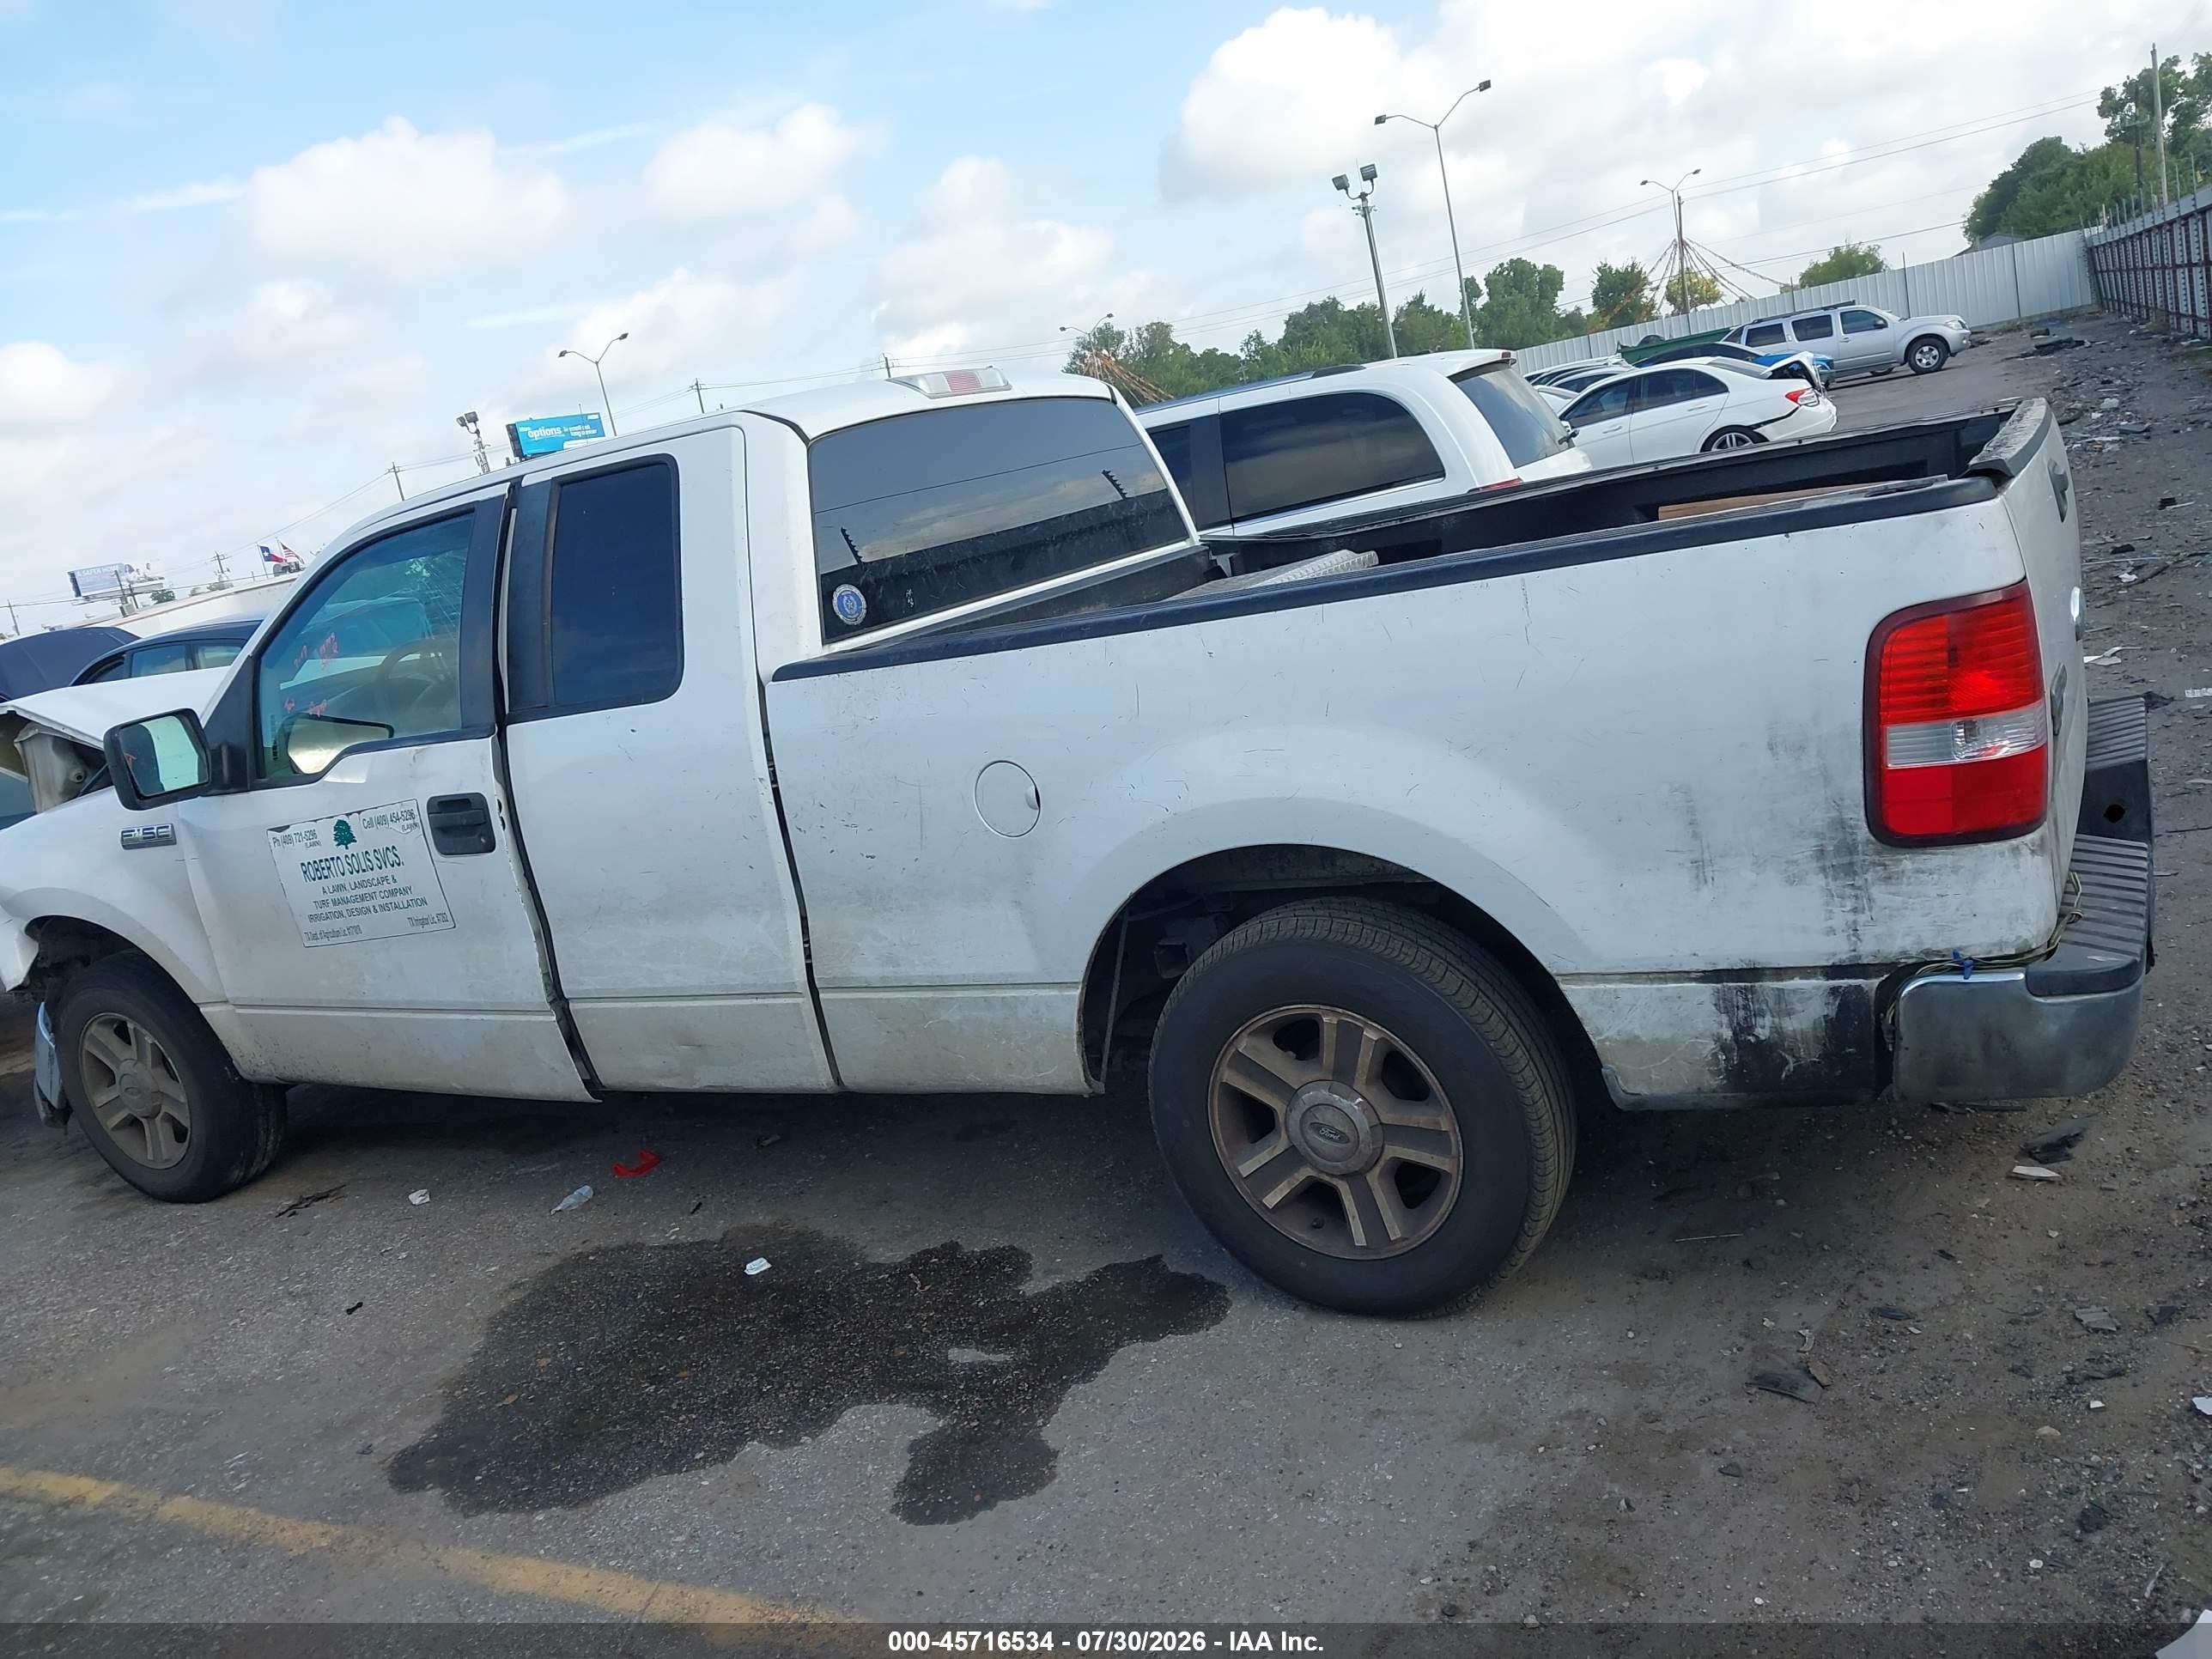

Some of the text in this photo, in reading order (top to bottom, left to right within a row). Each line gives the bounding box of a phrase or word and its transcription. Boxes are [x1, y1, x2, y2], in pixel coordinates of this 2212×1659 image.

[527, 425, 562, 440] options
[362, 817, 374, 829] Cell
[301, 845, 404, 883] ROBERTO SOLIS SVCS.
[322, 886, 328, 895] A
[349, 876, 390, 890] LANDSCAPE
[392, 874, 398, 884] &
[313, 885, 413, 909] TURF MANAGEMENT COMPANY
[347, 906, 371, 918] DESIGN
[372, 904, 378, 914] &
[379, 896, 428, 913] INSTALLATION
[1320, 1127, 1340, 1140] Ford
